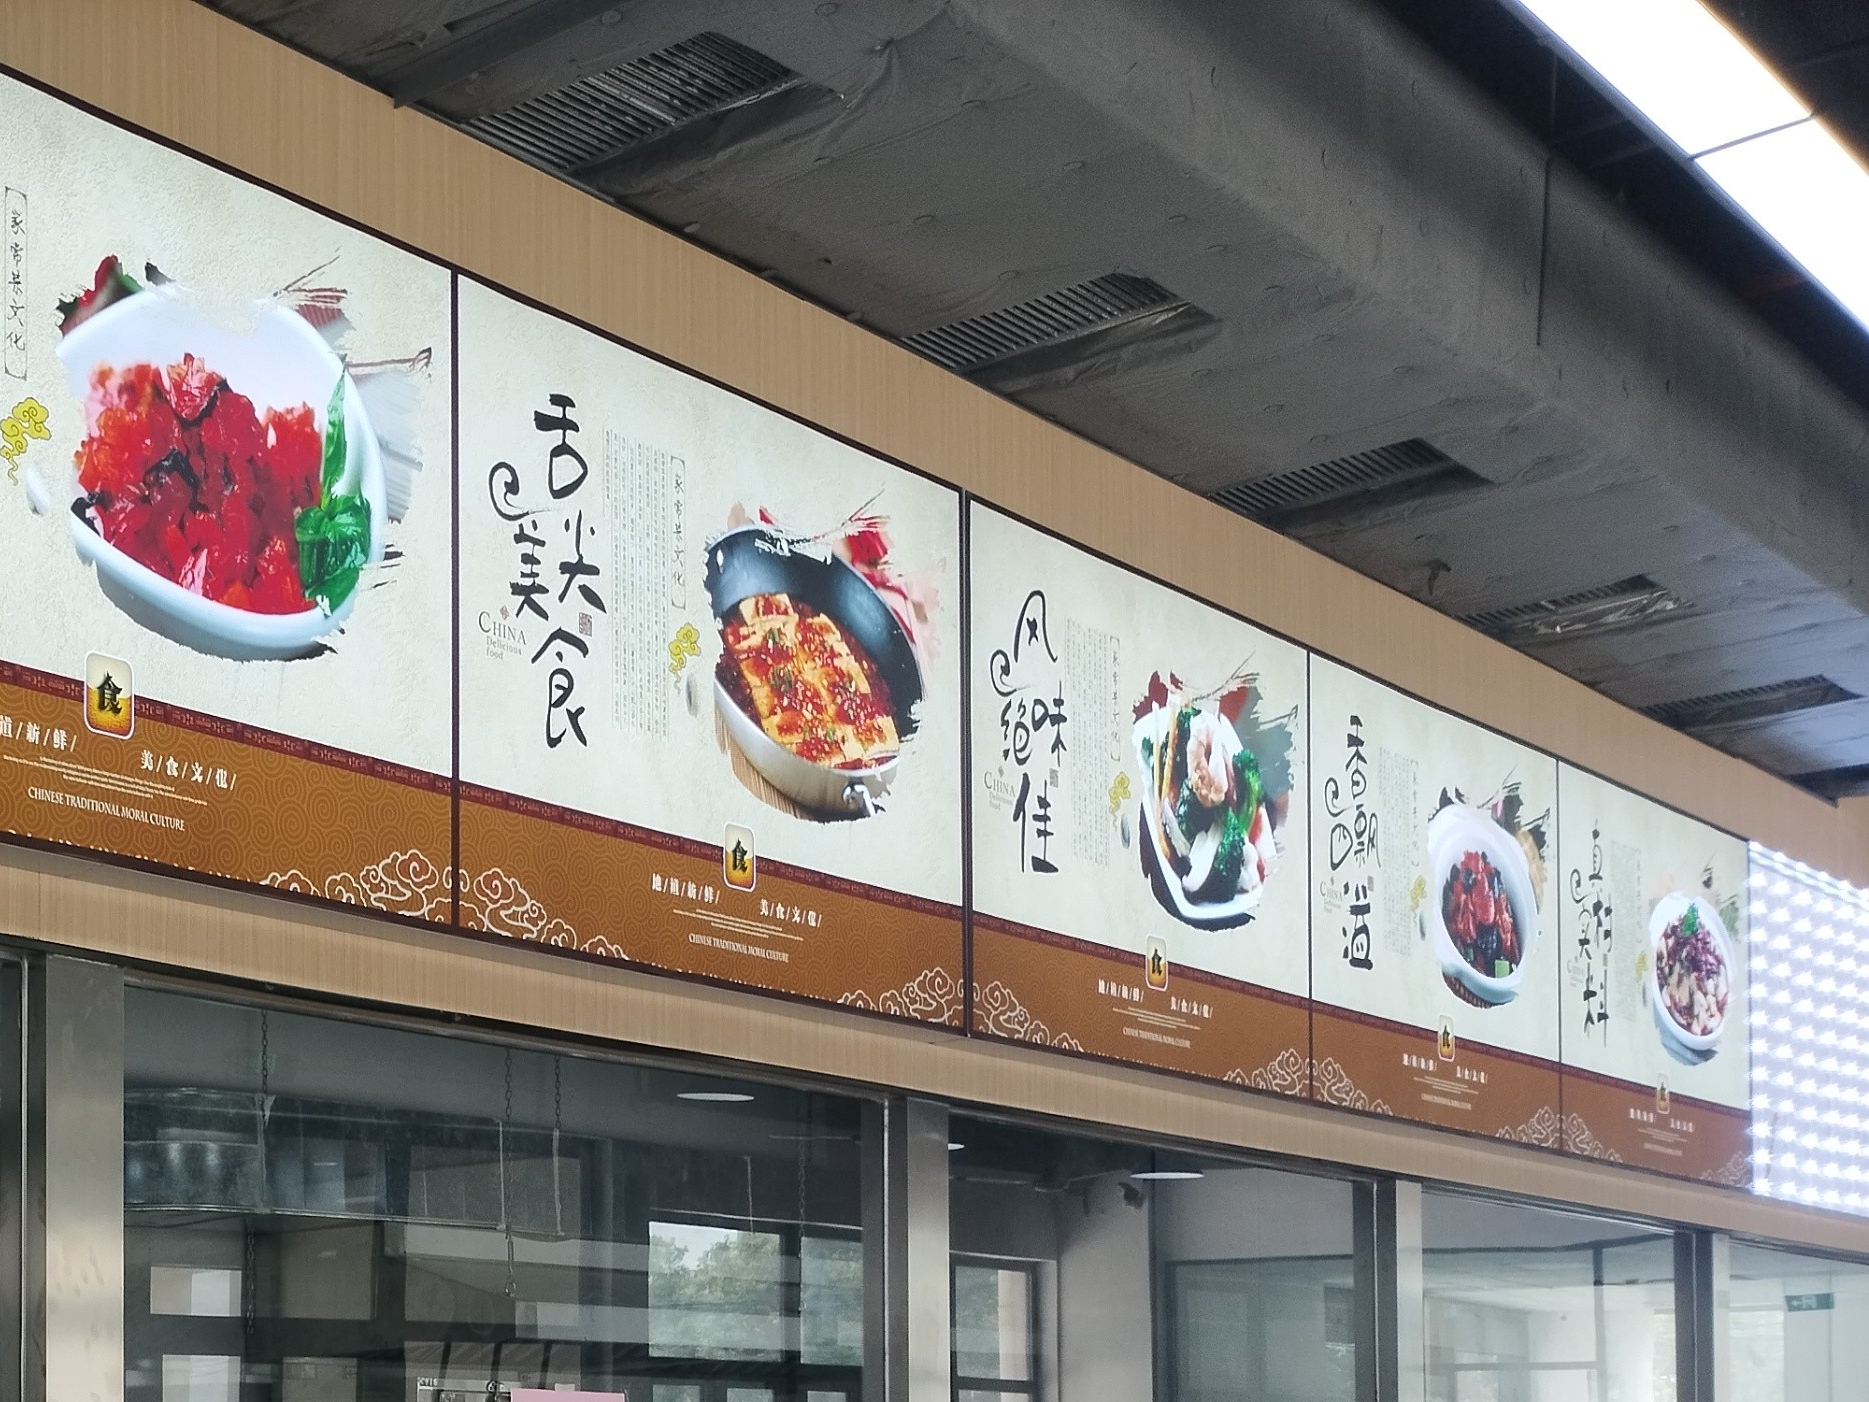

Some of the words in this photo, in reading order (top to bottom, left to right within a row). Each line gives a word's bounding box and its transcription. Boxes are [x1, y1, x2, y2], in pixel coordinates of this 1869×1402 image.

[510, 393, 607, 749] 舌尖美食
[96, 671, 123, 715] 食
[1000, 590, 1068, 874] 风味绝佳
[27, 786, 65, 805] CHINESE
[65, 792, 121, 818] TRADITIONAL
[121, 807, 149, 824] MORAL
[149, 813, 186, 832] CULTURE
